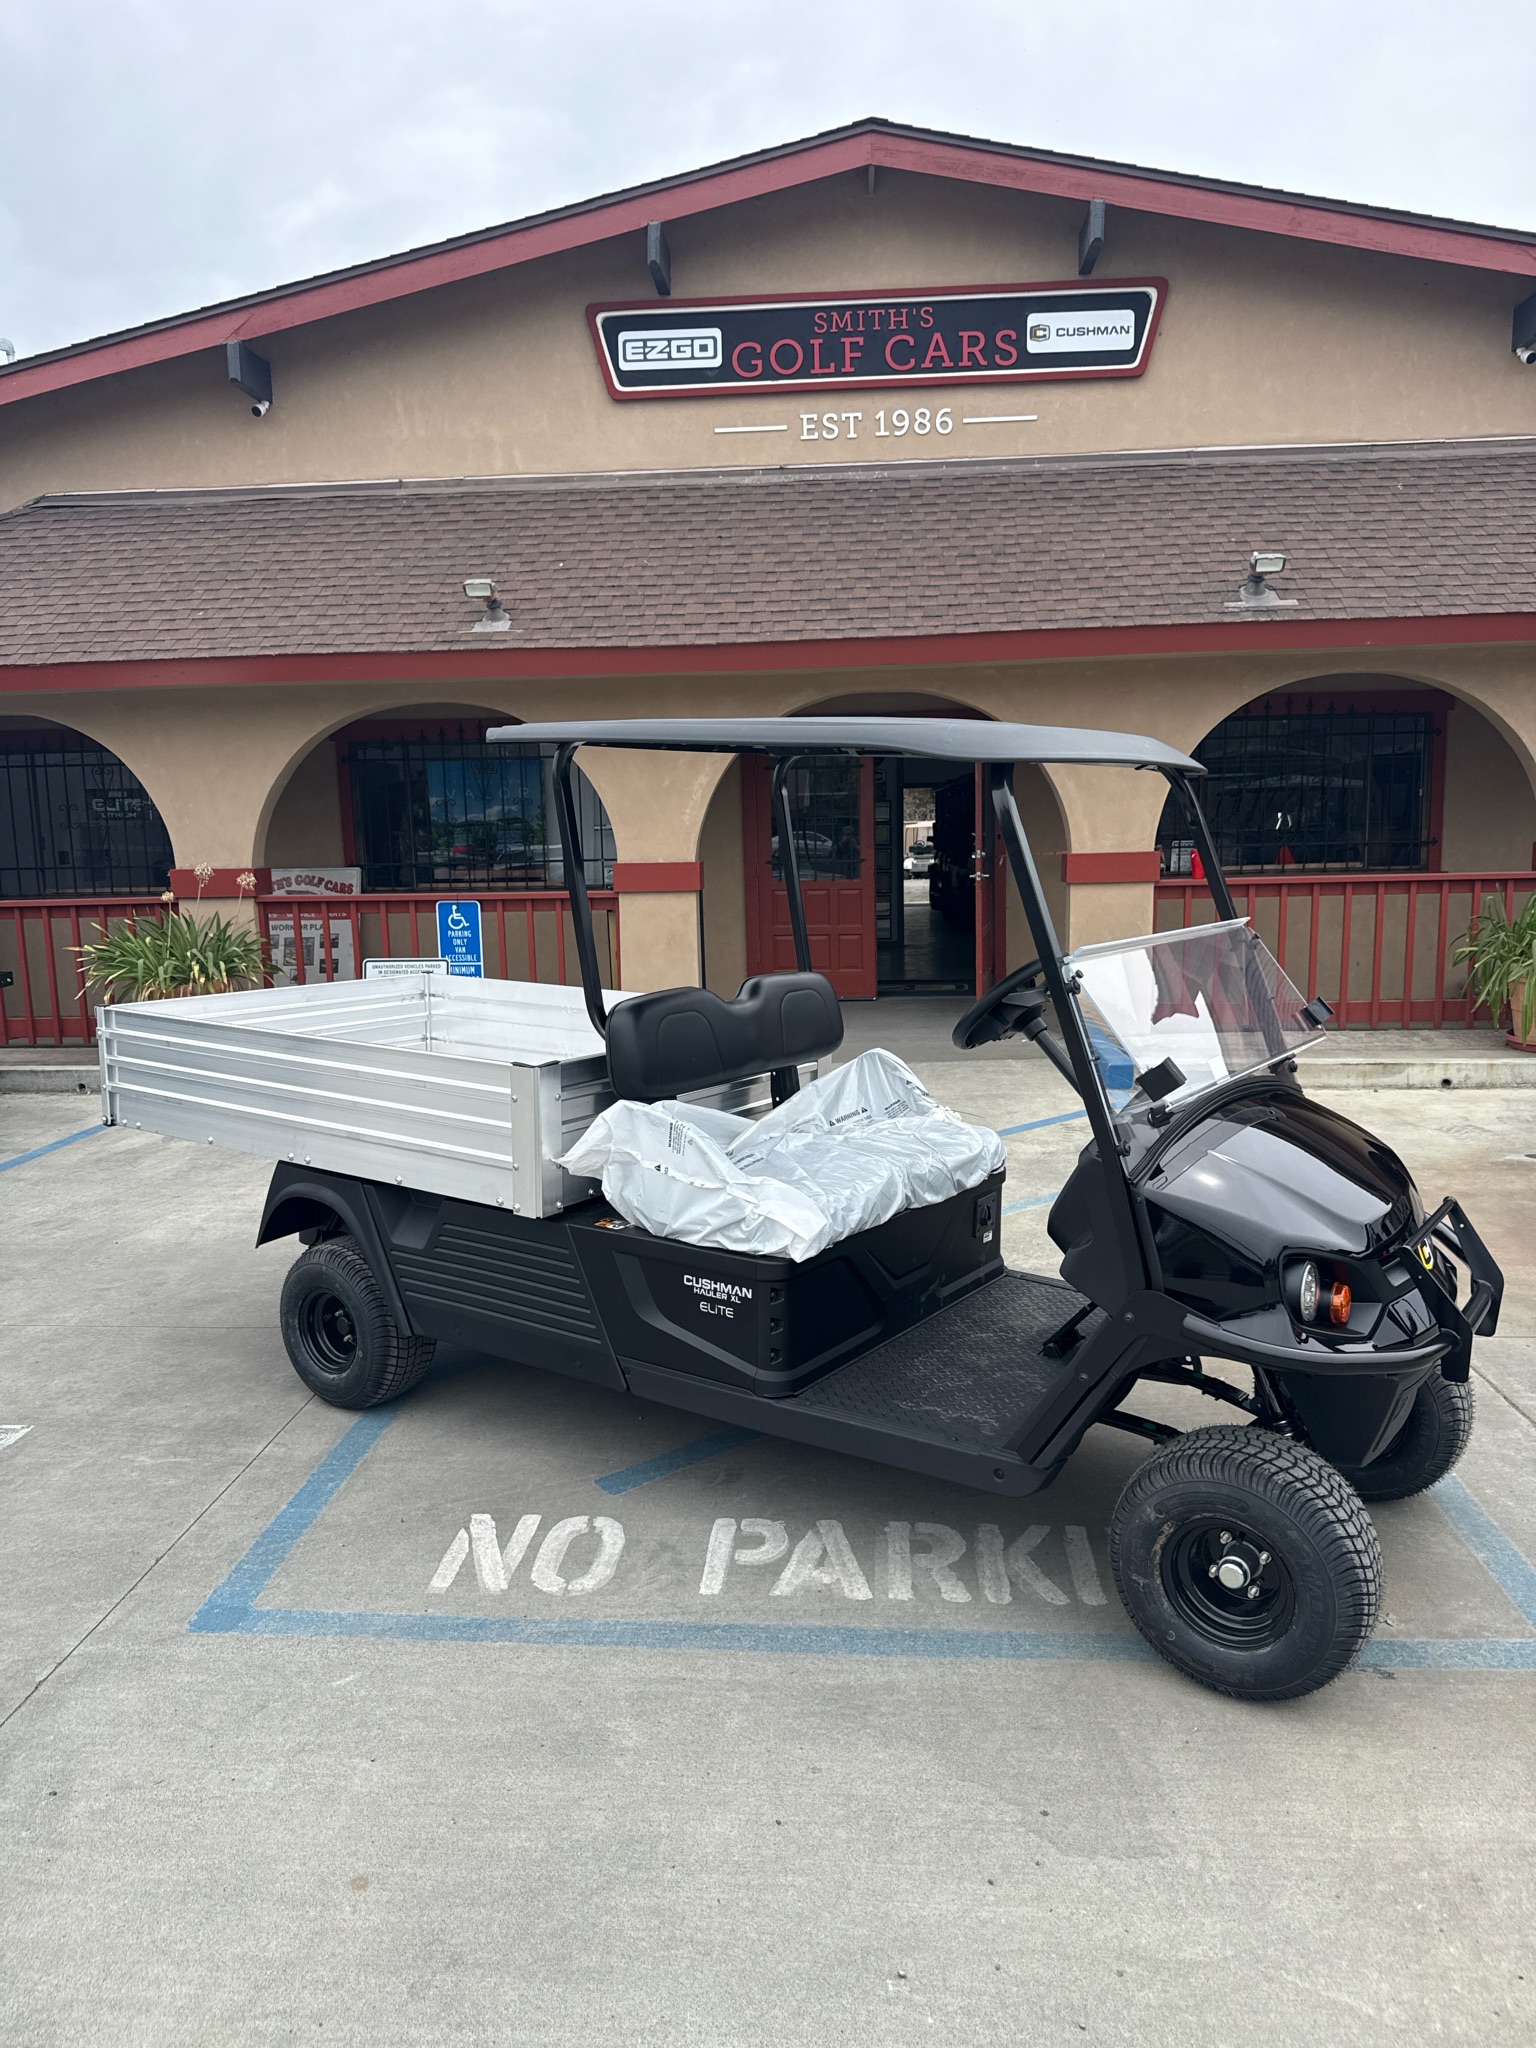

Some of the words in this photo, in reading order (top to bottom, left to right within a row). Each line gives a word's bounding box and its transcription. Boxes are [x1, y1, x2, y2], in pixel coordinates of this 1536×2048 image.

[814, 306, 934, 334] SMITH'S
[1055, 325, 1131, 338] CUSHMAN
[624, 337, 716, 362] EZGO
[731, 336, 864, 378] GOLF
[885, 329, 1018, 371] CARS
[800, 411, 863, 440] EST
[874, 408, 954, 437] 1986
[294, 874, 325, 888] GOLF
[324, 879, 354, 895] CARS
[309, 923, 324, 931] PLA
[447, 930, 472, 938] PARKING
[452, 938, 468, 946] ONLY
[834, 1109, 861, 1124] WARNING
[683, 1274, 752, 1299] CUSHMAN
[693, 1286, 728, 1301] HAULER
[730, 1294, 741, 1304] XL
[425, 1513, 626, 1598] NO
[699, 1517, 1109, 1606] PARKI
